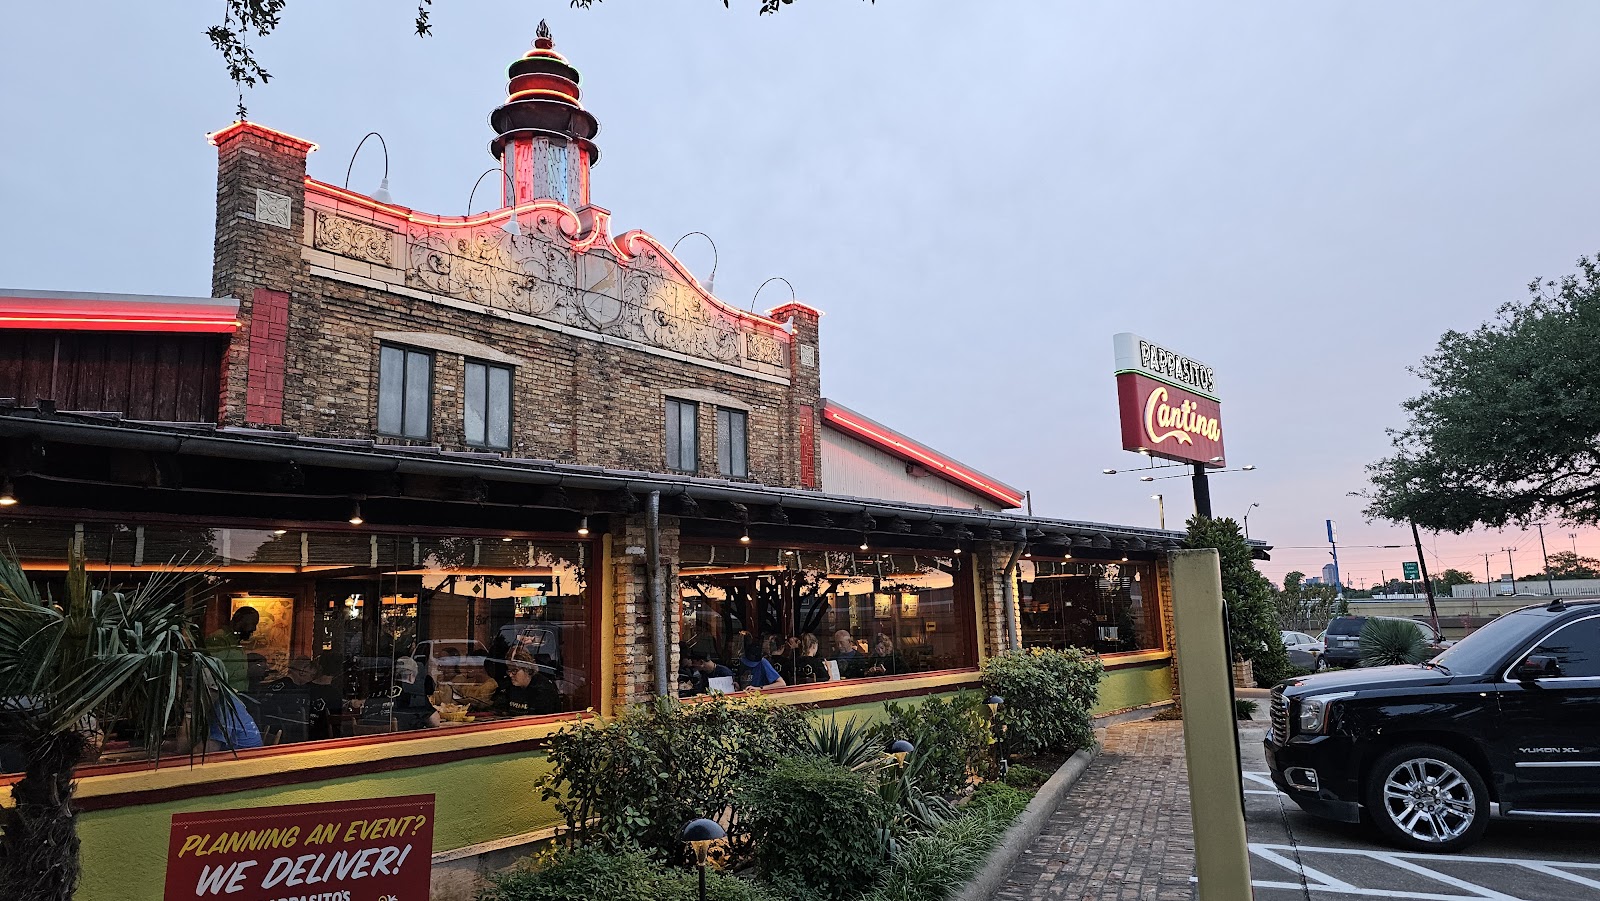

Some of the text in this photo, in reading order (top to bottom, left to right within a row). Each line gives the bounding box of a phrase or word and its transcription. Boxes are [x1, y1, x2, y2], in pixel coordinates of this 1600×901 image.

[1144, 387, 1220, 446] Cantina
[177, 814, 427, 858] PLANNING AN EVENT?
[194, 843, 413, 897] WE DELIVER!
